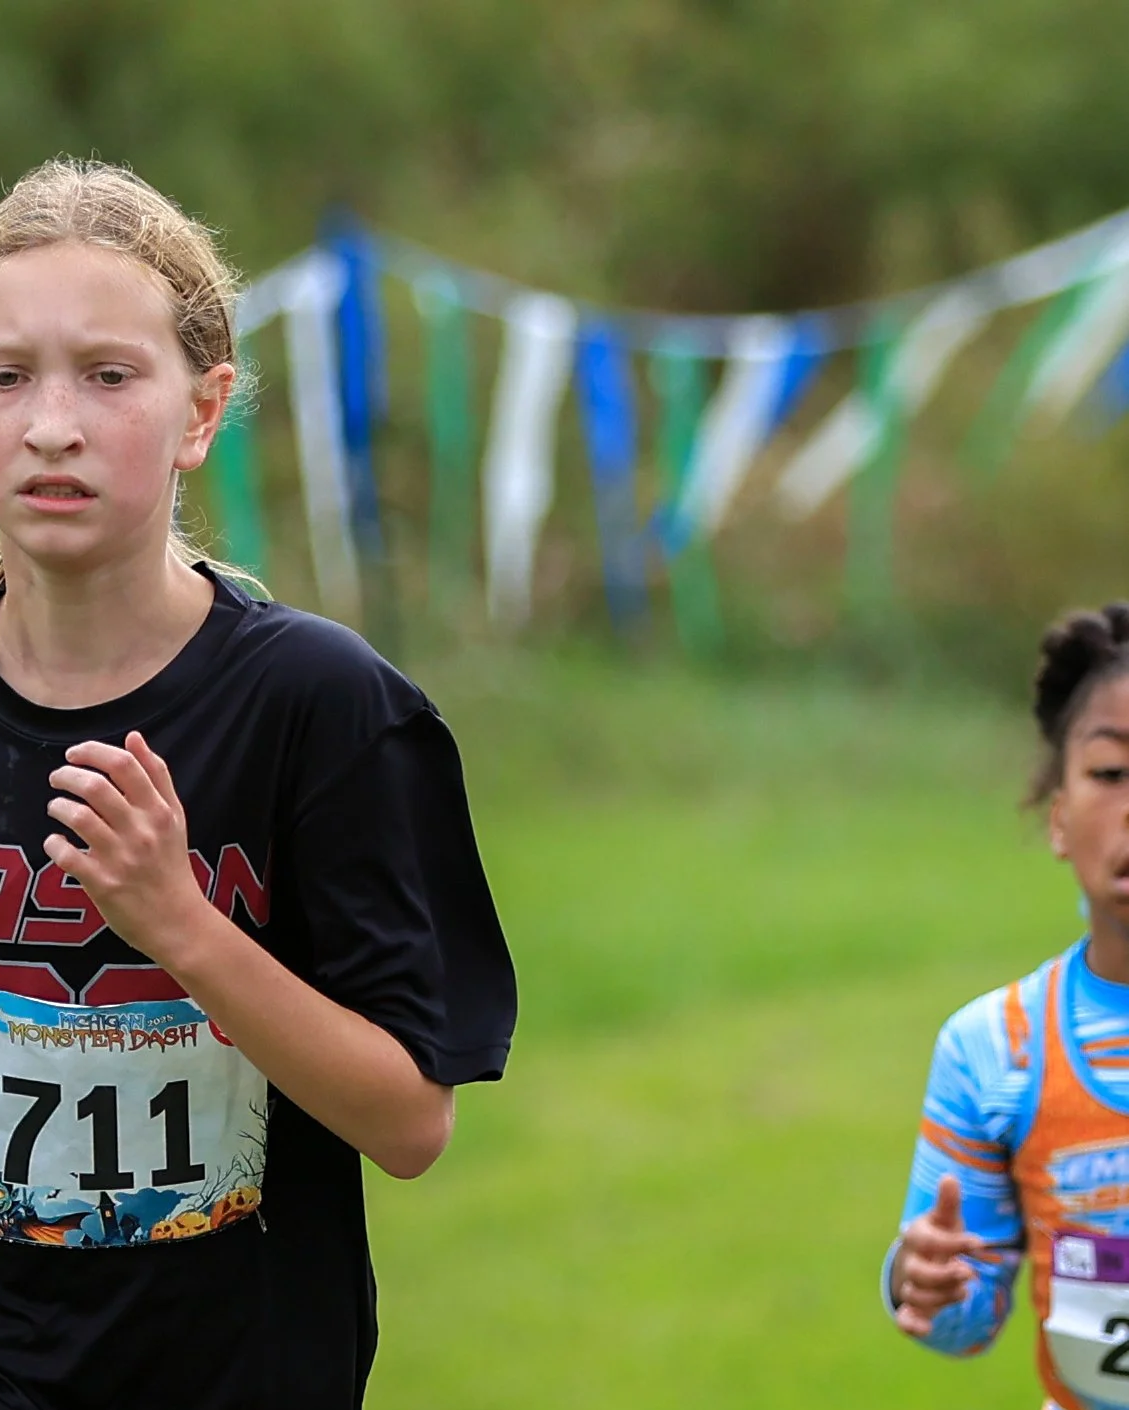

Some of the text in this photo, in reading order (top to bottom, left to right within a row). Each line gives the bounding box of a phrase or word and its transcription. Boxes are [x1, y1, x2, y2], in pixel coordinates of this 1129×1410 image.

[7, 1021, 199, 1053] MONSTER DASH
[58, 1011, 145, 1032] MICHIGAN
[1, 1074, 207, 1191] 711
